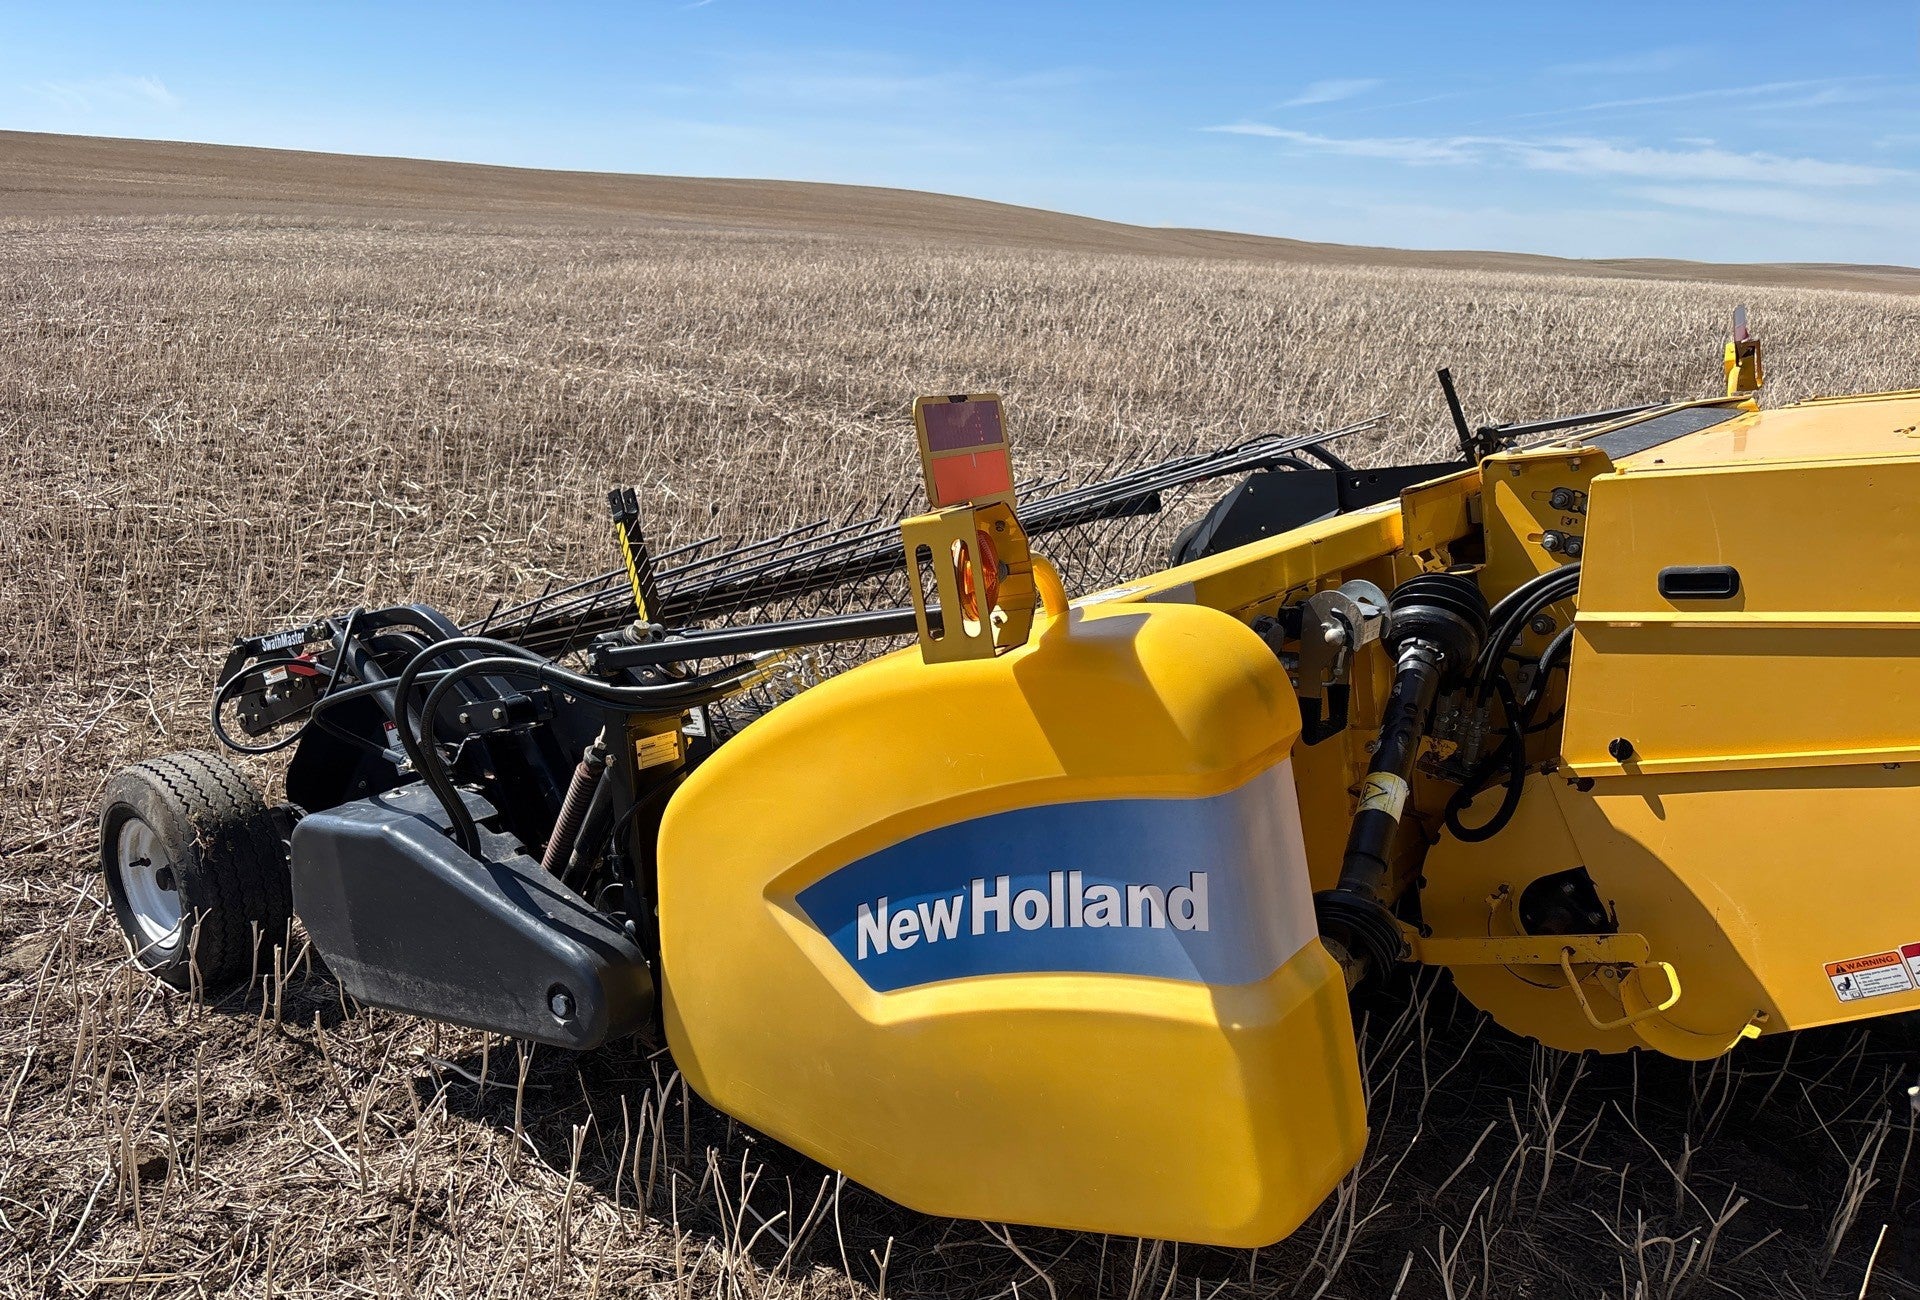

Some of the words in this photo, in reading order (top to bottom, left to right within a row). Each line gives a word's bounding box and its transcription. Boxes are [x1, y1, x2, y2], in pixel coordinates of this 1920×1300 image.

[262, 632, 304, 651] SwathMaster
[857, 896, 963, 960] New
[970, 870, 1209, 935] Holland
[1846, 956, 1893, 970] WARNING
